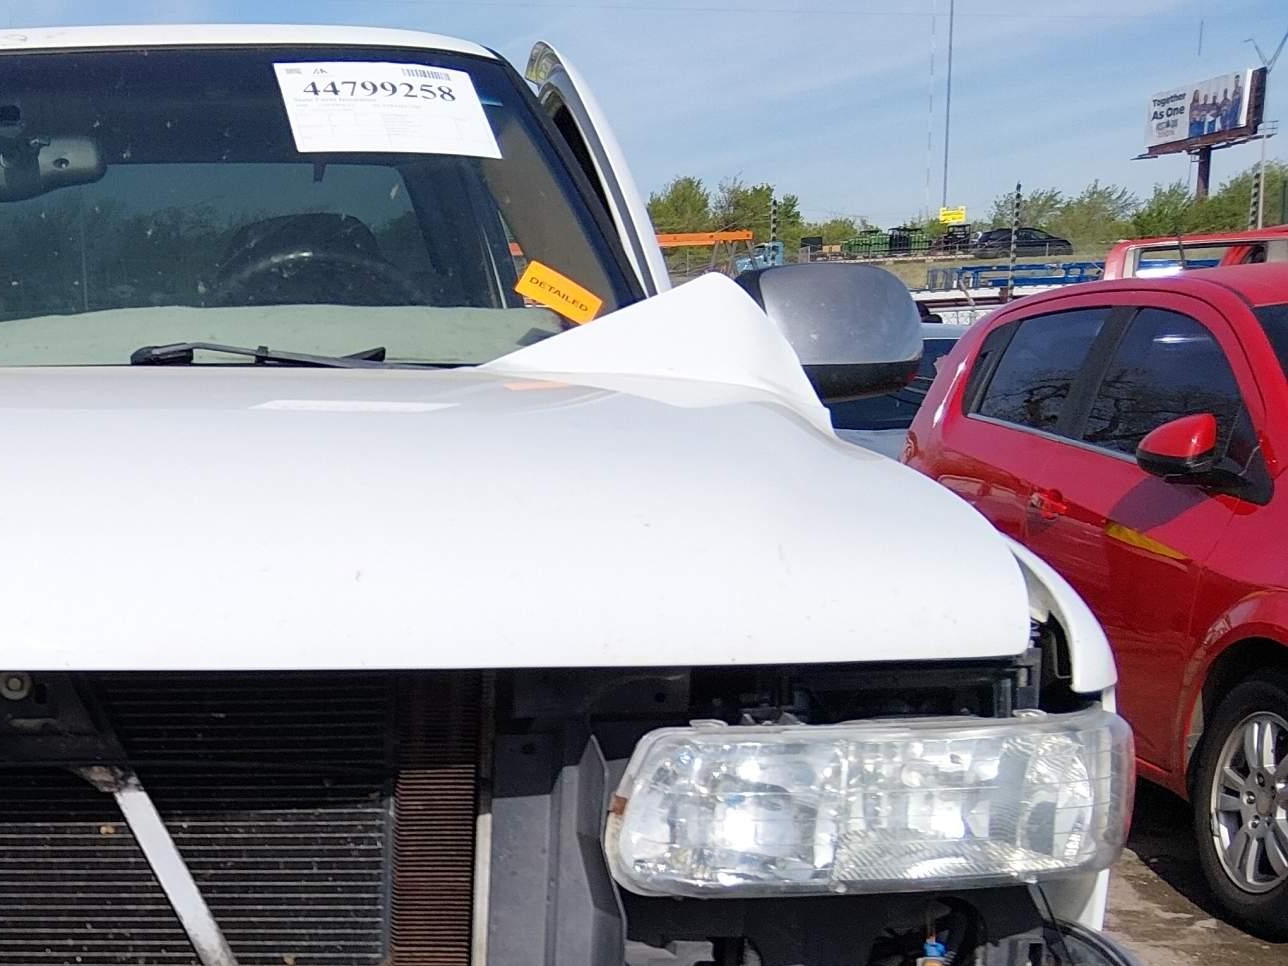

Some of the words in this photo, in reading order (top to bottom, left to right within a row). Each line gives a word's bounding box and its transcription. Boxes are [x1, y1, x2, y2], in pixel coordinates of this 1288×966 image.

[303, 80, 456, 102] 44799258
[1152, 92, 1187, 107] Together
[1151, 110, 1164, 121] As
[1166, 105, 1185, 117] One
[529, 276, 589, 312] DETAILED
